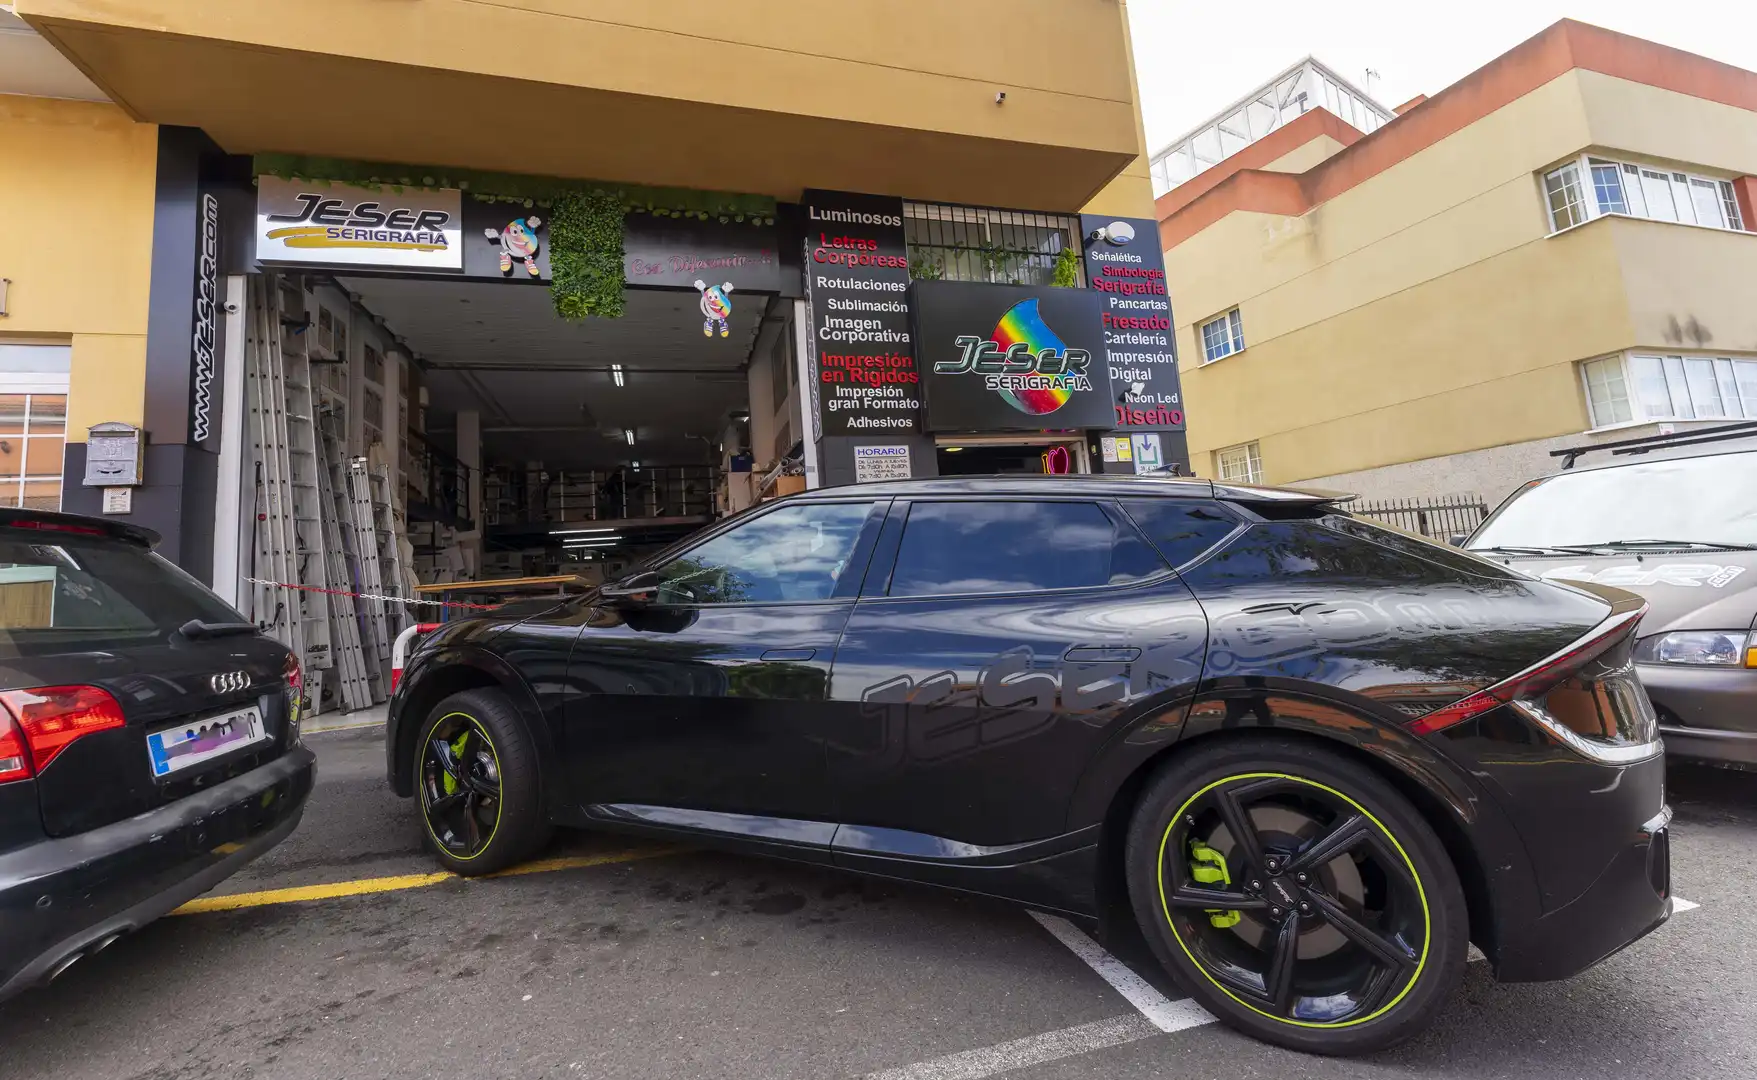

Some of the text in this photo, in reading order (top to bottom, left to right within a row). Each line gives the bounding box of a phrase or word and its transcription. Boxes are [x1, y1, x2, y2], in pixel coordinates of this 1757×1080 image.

[266, 193, 450, 232] JESER
[809, 205, 902, 227] Luminosos
[326, 227, 449, 245] SERIGRAFIA
[819, 232, 879, 252] Letras
[813, 247, 908, 269] Corpóreas
[1091, 250, 1142, 264] Señalética
[816, 276, 906, 292] Rotulaciones
[827, 298, 908, 313] Sublimación
[1109, 297, 1168, 310] Pancartas
[825, 314, 882, 332] Imagen
[1102, 312, 1170, 330] Fresado
[819, 326, 910, 344] Corporativa
[1104, 331, 1167, 346] Cartelería
[821, 351, 913, 371] Impresión
[934, 335, 1092, 376] JESER
[1107, 349, 1174, 365] Impresión
[821, 366, 919, 388] en Rígidos
[1109, 366, 1152, 383] Digital
[985, 375, 1092, 391] SERIGRAFIA
[835, 385, 904, 399] Impresión
[1157, 392, 1178, 403] Led
[828, 397, 920, 412] gran Formato
[846, 416, 913, 428] Adhesivos
[858, 448, 906, 456] HORARIO
